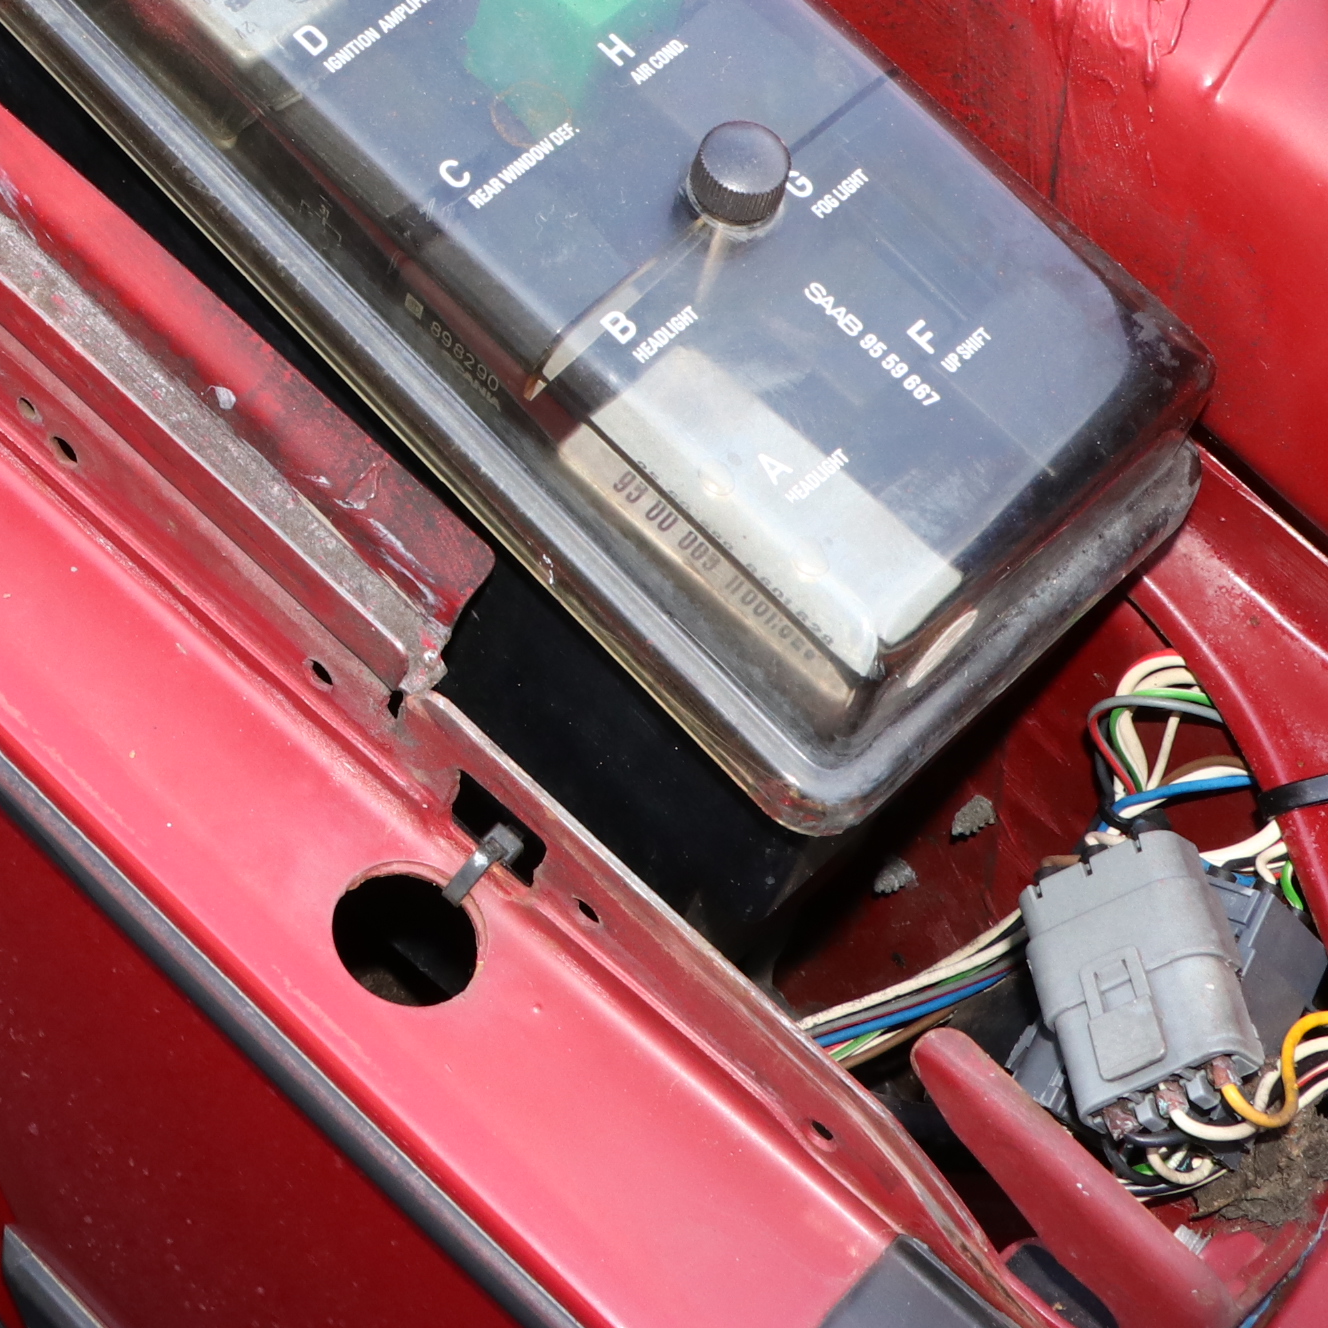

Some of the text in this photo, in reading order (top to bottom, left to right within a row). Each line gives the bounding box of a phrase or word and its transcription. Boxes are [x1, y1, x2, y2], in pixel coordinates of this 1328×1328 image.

[291, 21, 329, 57] D
[322, 27, 381, 73] IGNITION
[596, 33, 636, 67] H
[629, 37, 688, 84] AIR COND.
[438, 159, 471, 188] C
[466, 120, 580, 208] REAR WINDOW DEF.
[810, 169, 869, 218] FOG LIGHT
[598, 309, 637, 345] B
[631, 306, 700, 362] HEADLIGHT
[801, 280, 941, 408] SAAB 95 59 667
[906, 318, 935, 355] F
[940, 327, 993, 373] UP SHIFT
[750, 447, 793, 485] A
[784, 449, 851, 505] HEADLIGHT
